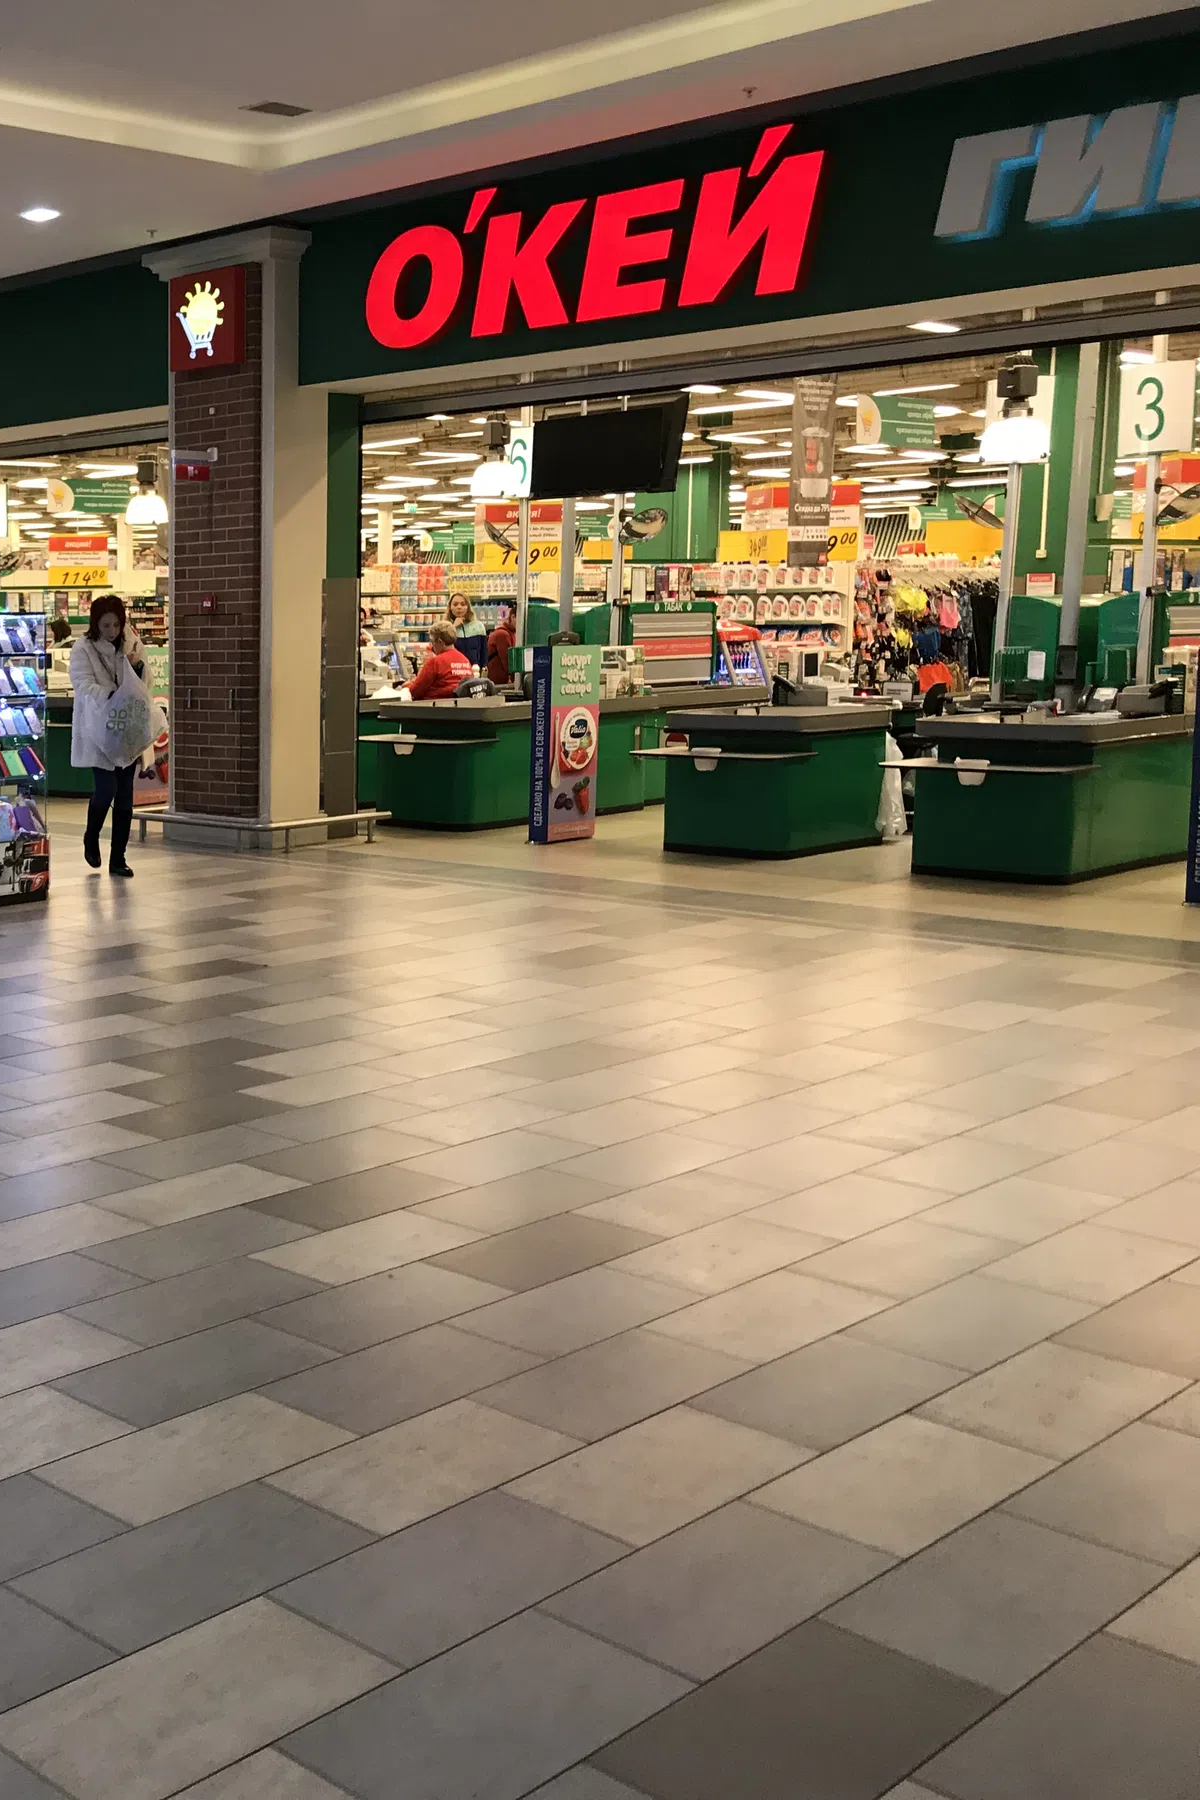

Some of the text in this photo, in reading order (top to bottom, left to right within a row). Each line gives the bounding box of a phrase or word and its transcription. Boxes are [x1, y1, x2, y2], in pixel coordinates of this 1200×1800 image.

[1135, 377, 1165, 441] 3
[664, 602, 683, 612] ТАБАК
[536, 678, 546, 710] МОЛОКА
